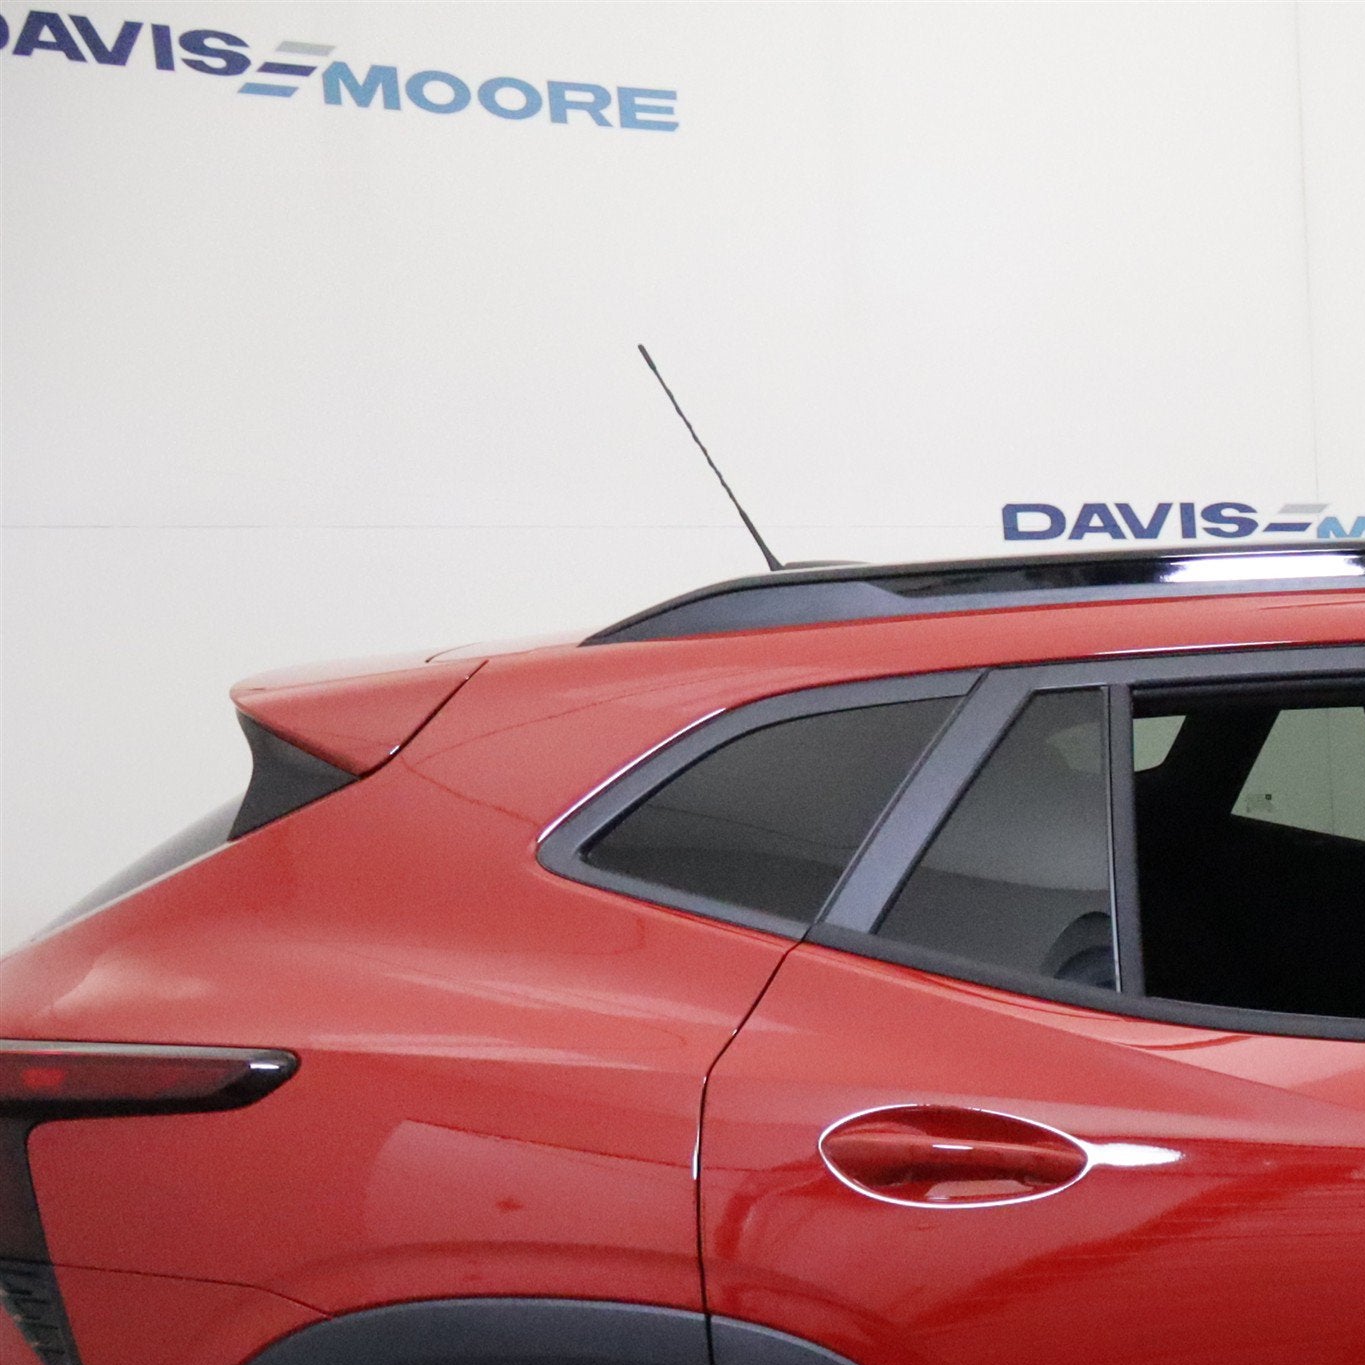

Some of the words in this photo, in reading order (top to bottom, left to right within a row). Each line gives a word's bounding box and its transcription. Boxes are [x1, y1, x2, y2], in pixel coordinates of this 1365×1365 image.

[0, 9, 252, 77] AVIS
[321, 60, 679, 132] MOORE
[1002, 501, 1260, 541] DAVIS
